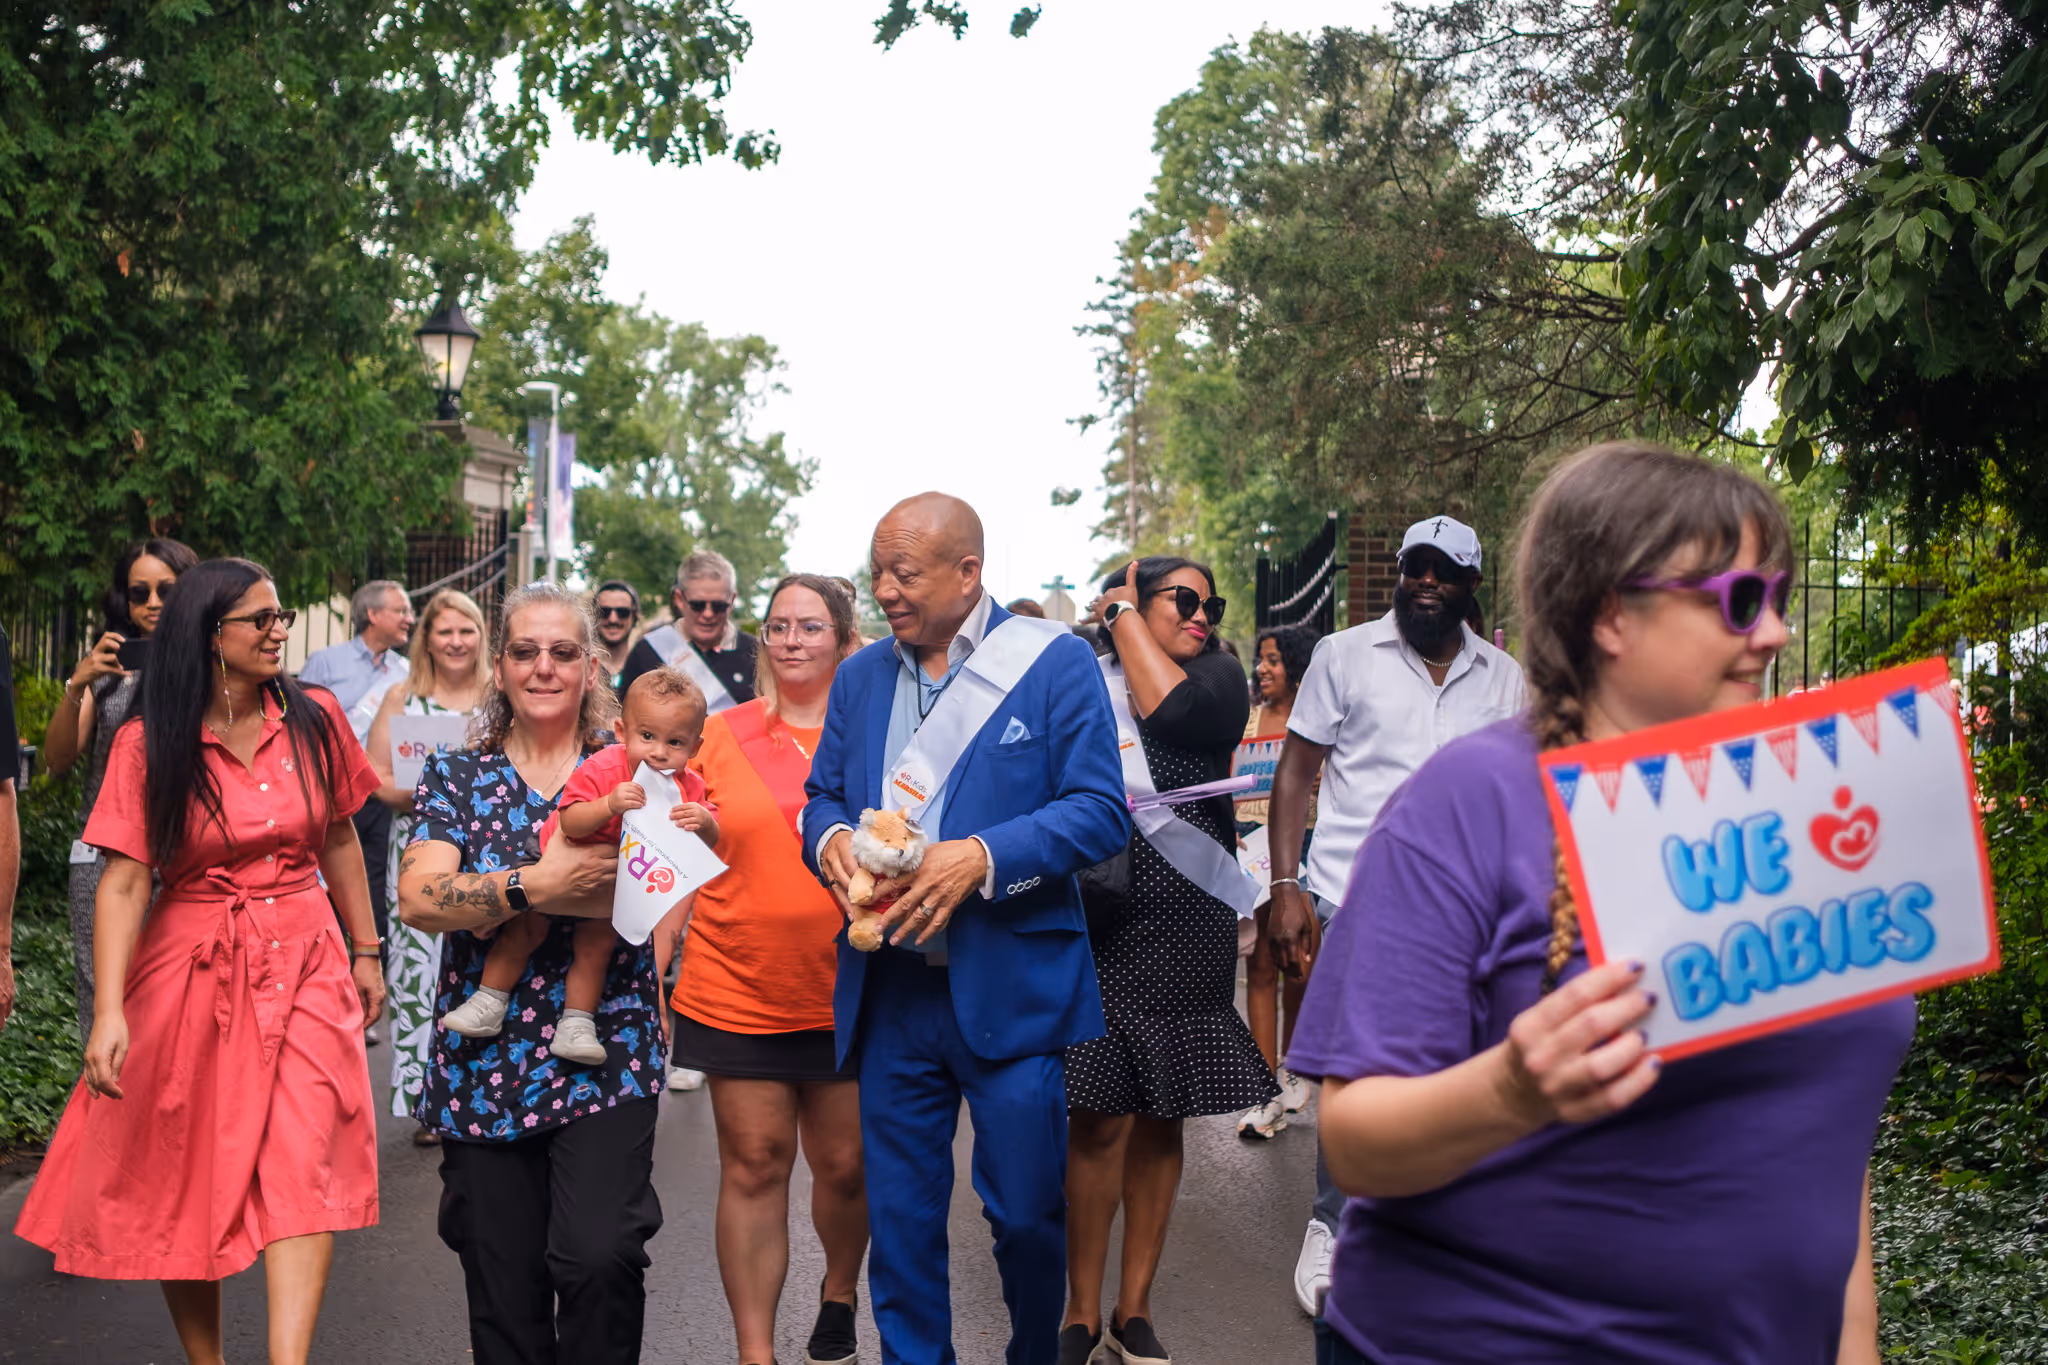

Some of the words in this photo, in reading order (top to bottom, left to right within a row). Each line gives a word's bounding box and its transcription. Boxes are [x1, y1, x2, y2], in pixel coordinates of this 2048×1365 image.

[893, 779, 925, 802] MARSHAL
[1662, 811, 1791, 913] WE
[1662, 881, 1935, 1021] BABIES
